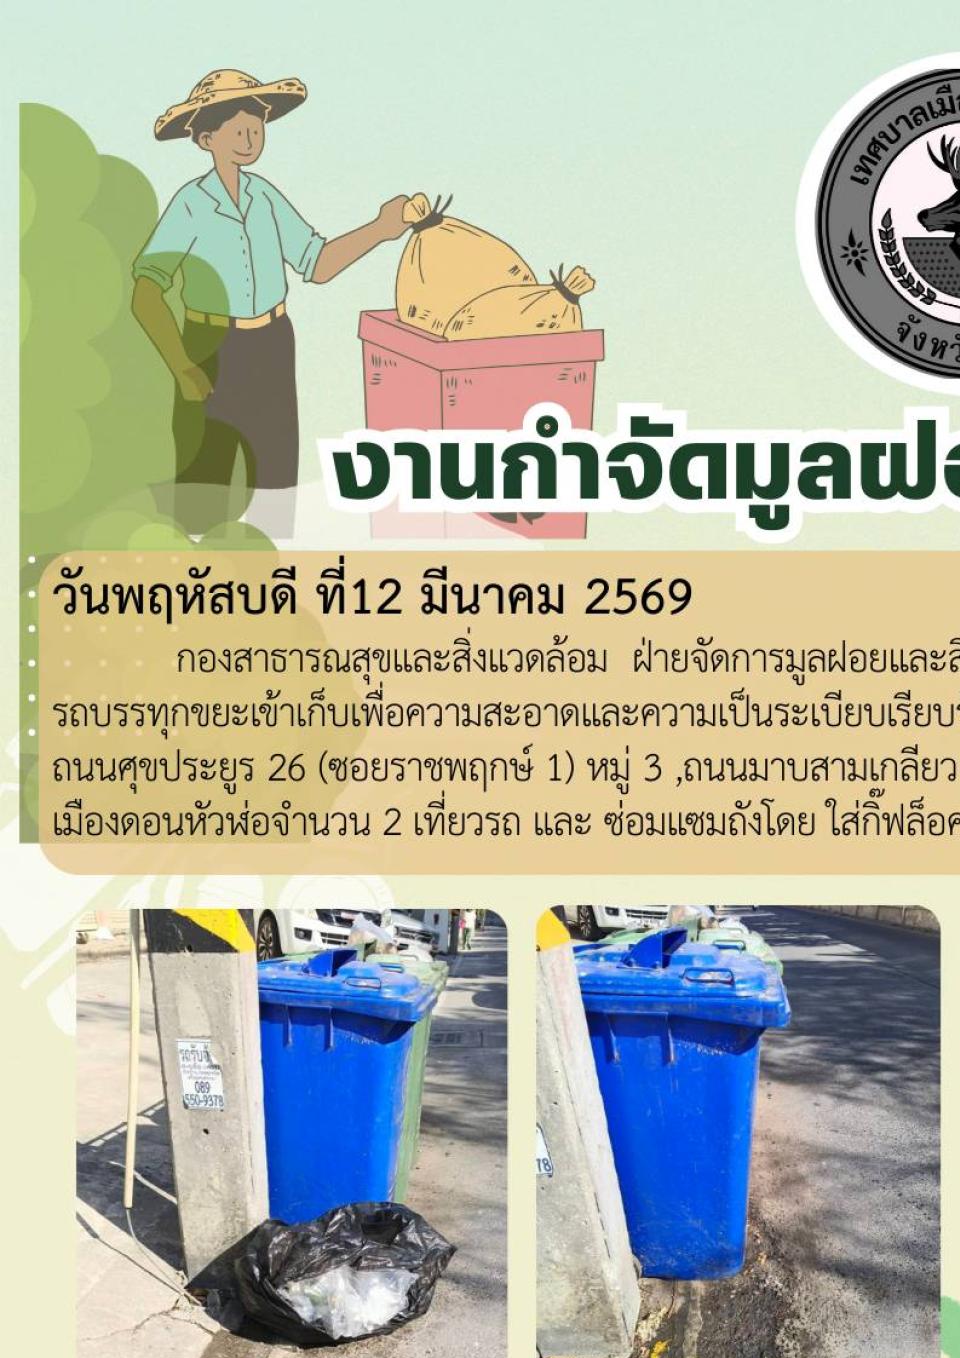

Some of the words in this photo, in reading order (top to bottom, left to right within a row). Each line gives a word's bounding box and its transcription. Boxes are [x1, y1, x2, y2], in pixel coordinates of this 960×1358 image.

[52, 566, 297, 623] วันพฤหัสบดี
[315, 557, 402, 615] ที่12
[420, 566, 564, 615] มีนาคม
[585, 577, 692, 616] 2569
[177, 627, 607, 687] กองสาธารณสุขและสิ่งแวดล้อม
[52, 748, 254, 795] ถนนศุขประยูร
[268, 753, 306, 783] 26
[318, 744, 534, 794] (ซอยราชพฤกษ์
[548, 750, 575, 785] 1)
[586, 745, 629, 795] หมู่
[644, 753, 662, 783] 3
[53, 798, 371, 837] เมืองดอนหัวฬ่อจำนวน
[383, 807, 402, 836] 2
[414, 793, 520, 836] เที่ยวรถ
[534, 811, 592, 836] และ
[603, 798, 815, 836] ซ่อมแซมถังโดย
